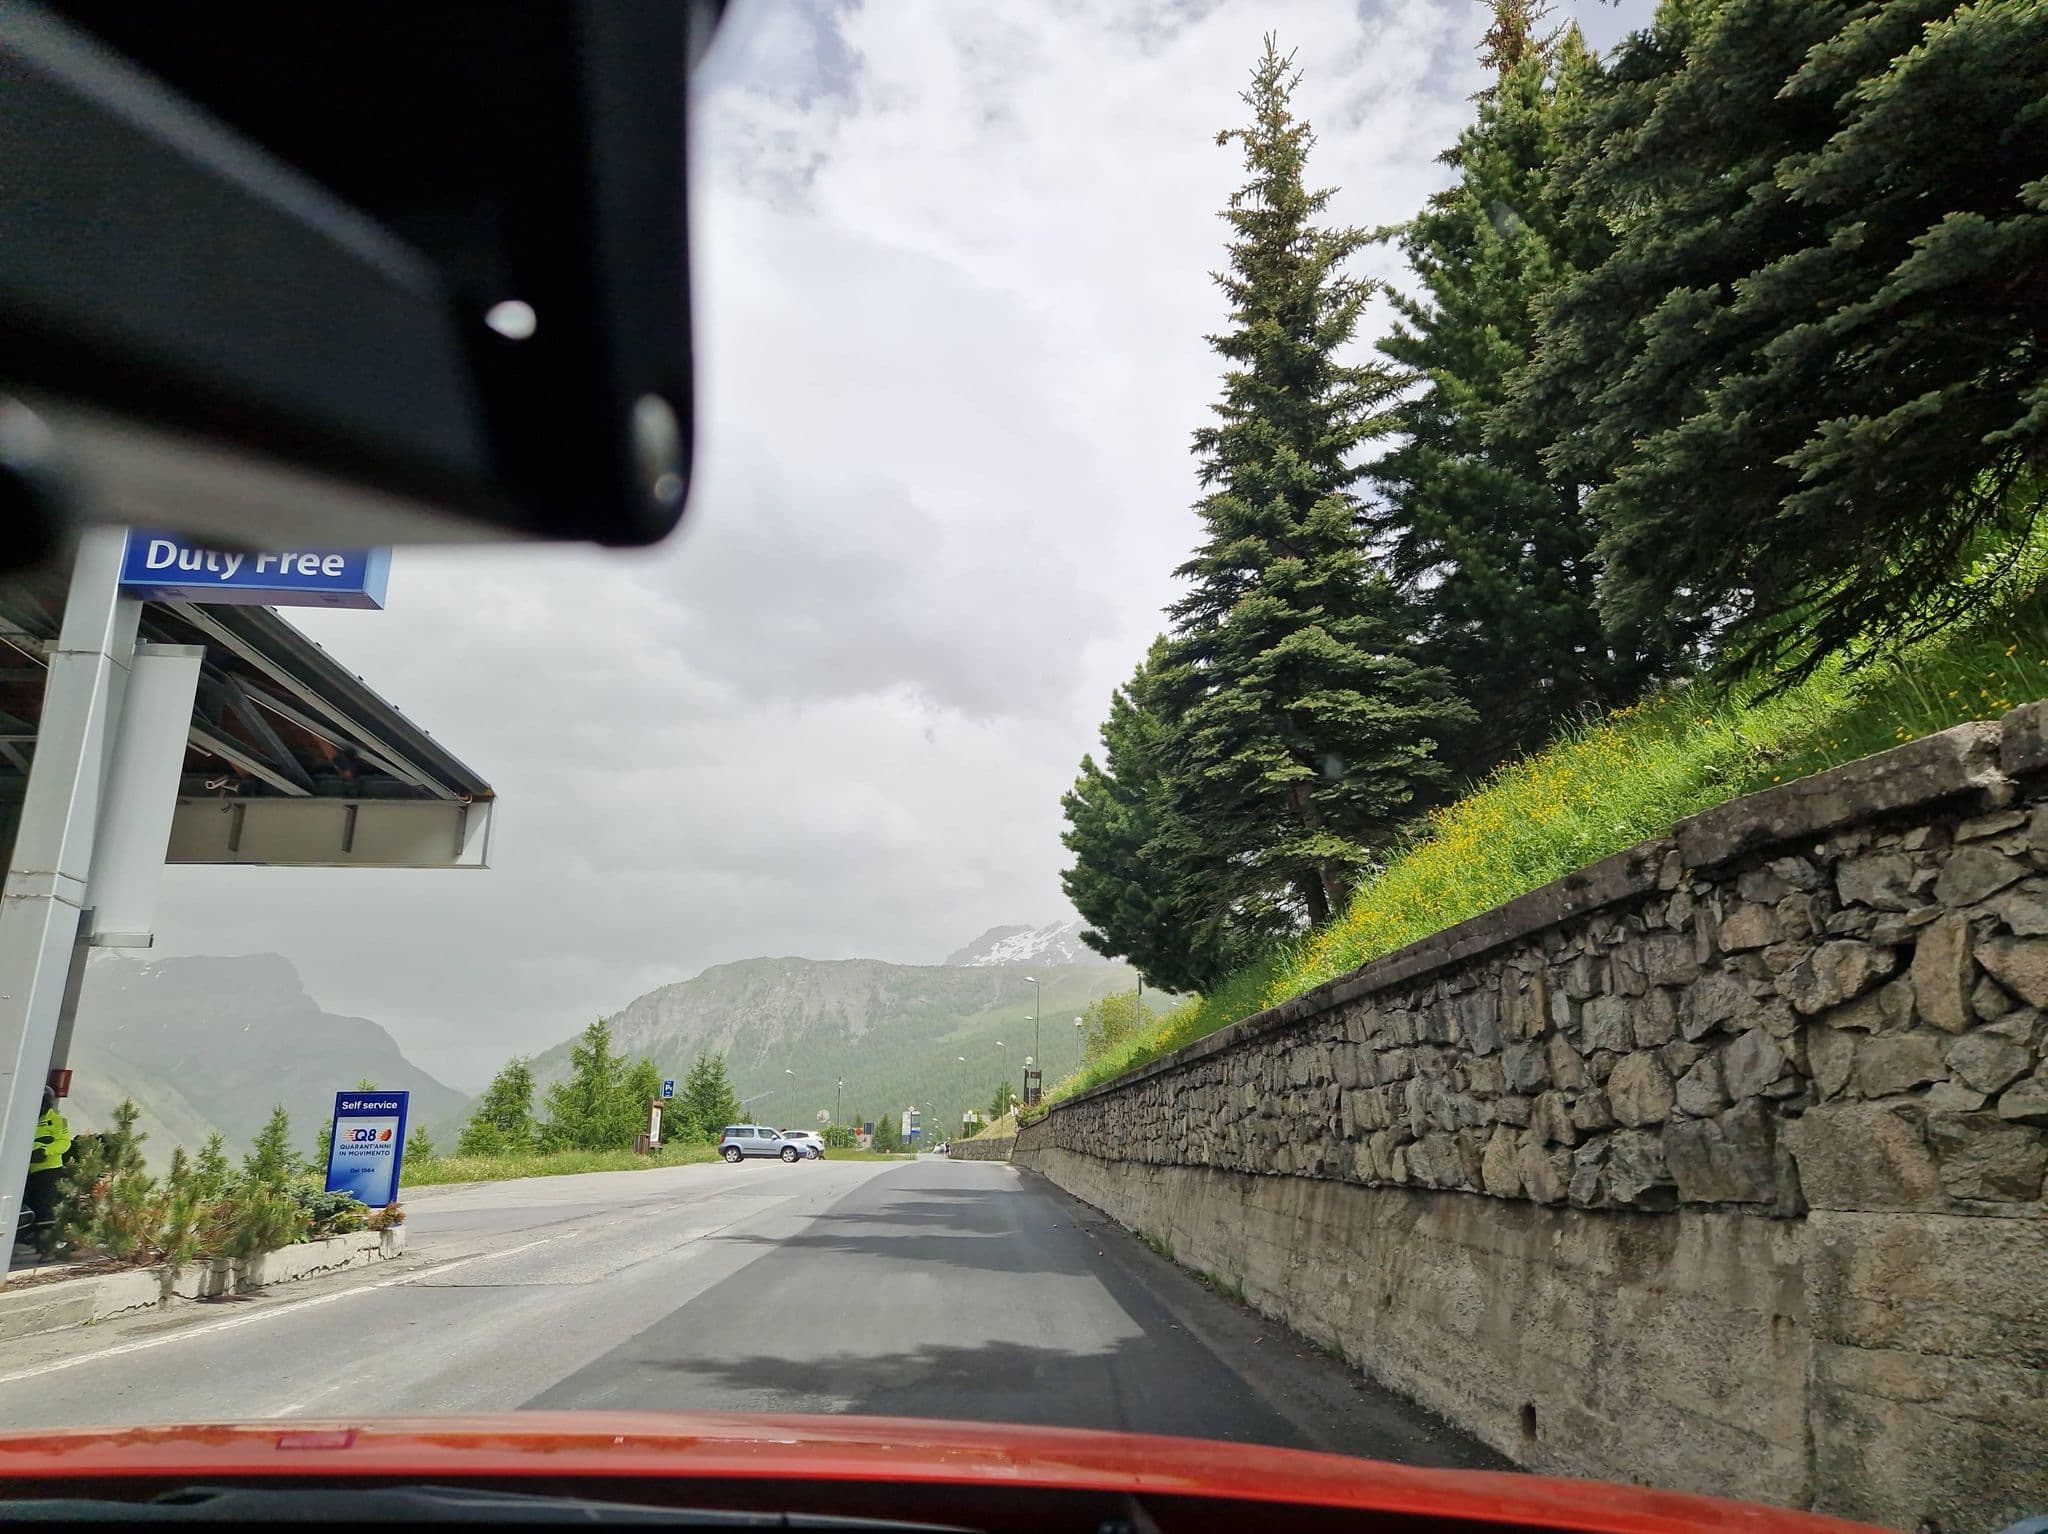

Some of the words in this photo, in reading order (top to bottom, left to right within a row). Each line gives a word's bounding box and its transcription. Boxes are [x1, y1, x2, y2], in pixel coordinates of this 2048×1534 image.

[146, 539, 244, 580] Duty
[256, 550, 345, 577] Free
[342, 1100, 362, 1110] Self
[363, 1100, 398, 1109] service
[354, 1128, 377, 1142] Q8
